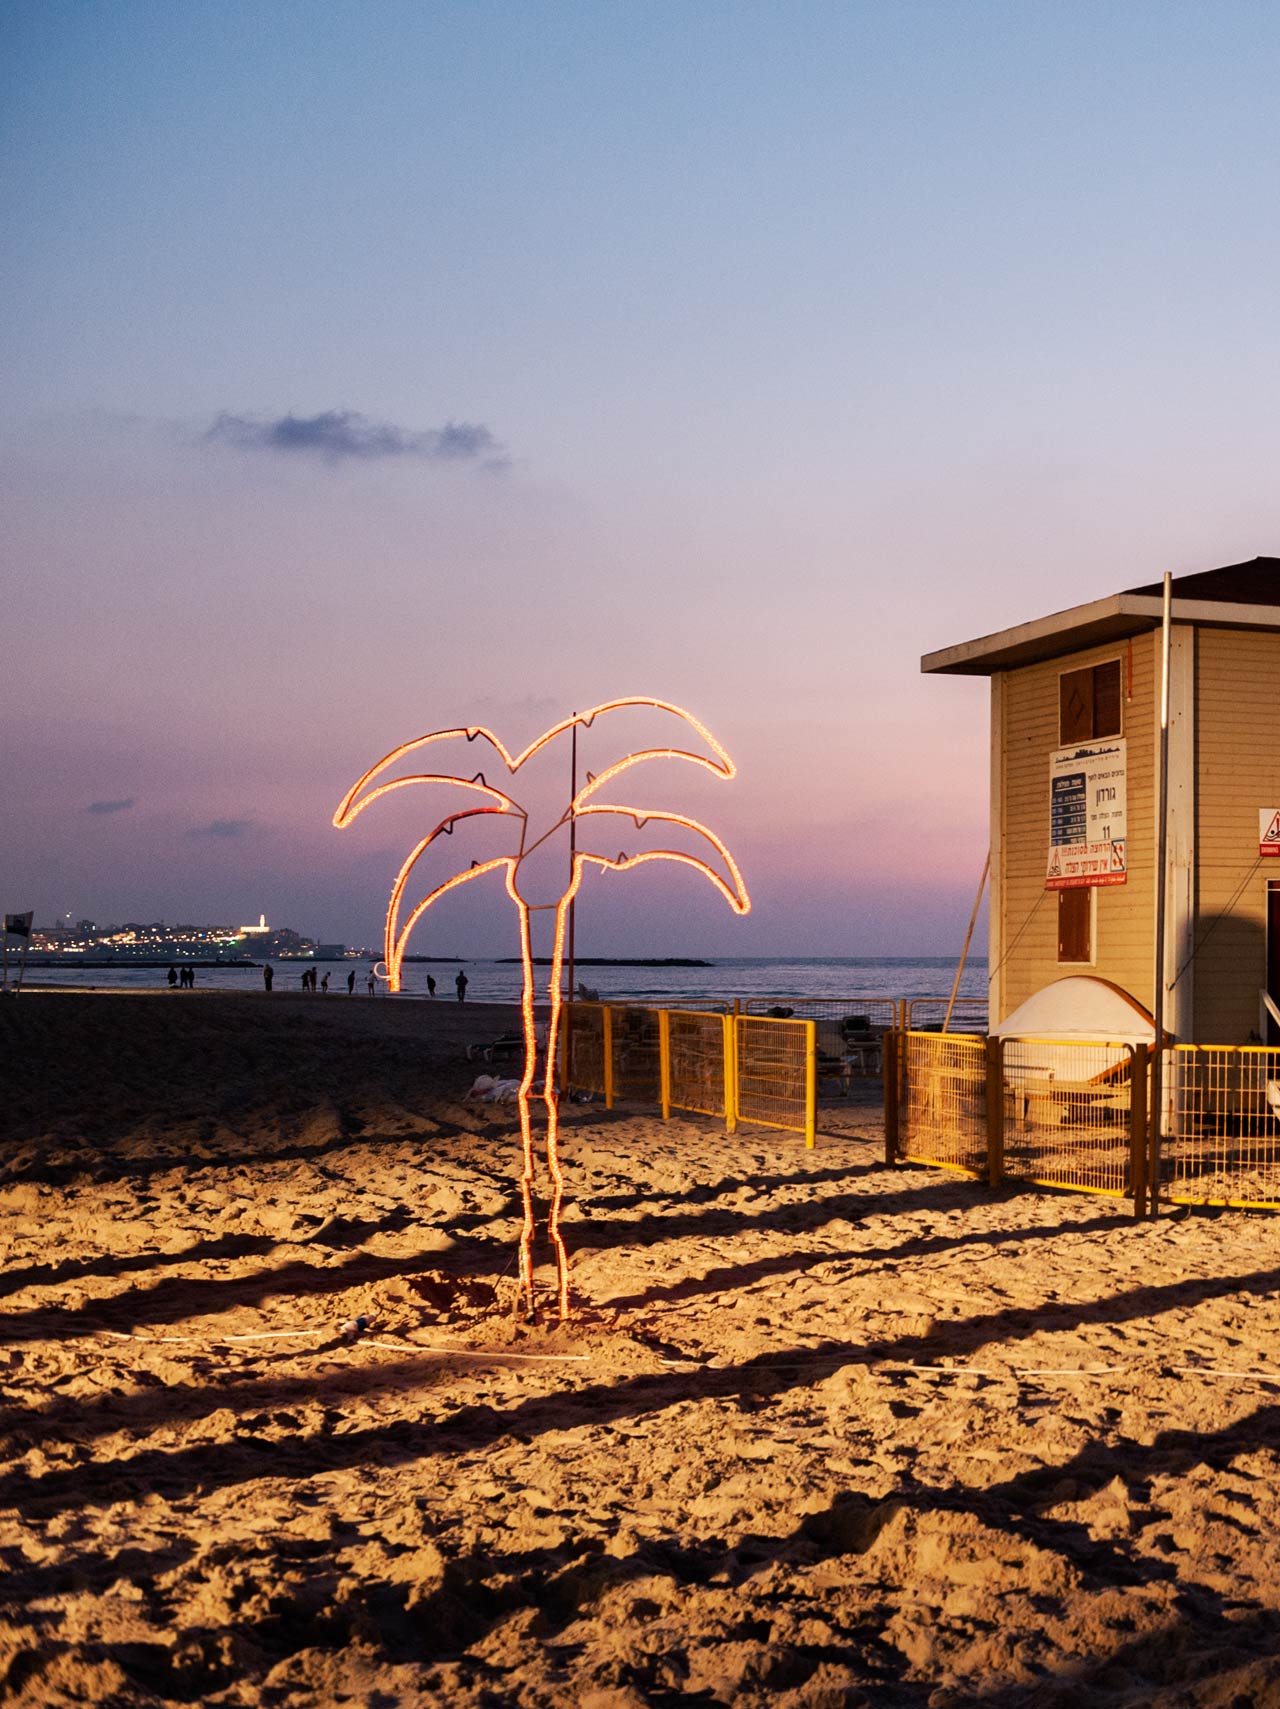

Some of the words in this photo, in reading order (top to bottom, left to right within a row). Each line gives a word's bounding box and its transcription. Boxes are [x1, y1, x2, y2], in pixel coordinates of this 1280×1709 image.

[1095, 787, 1116, 807] גורדון
[1102, 825, 1110, 839] 11
[1090, 842, 1111, 853] הרחצה
[1065, 861, 1079, 873] הצלה
[1099, 859, 1109, 873] אין
